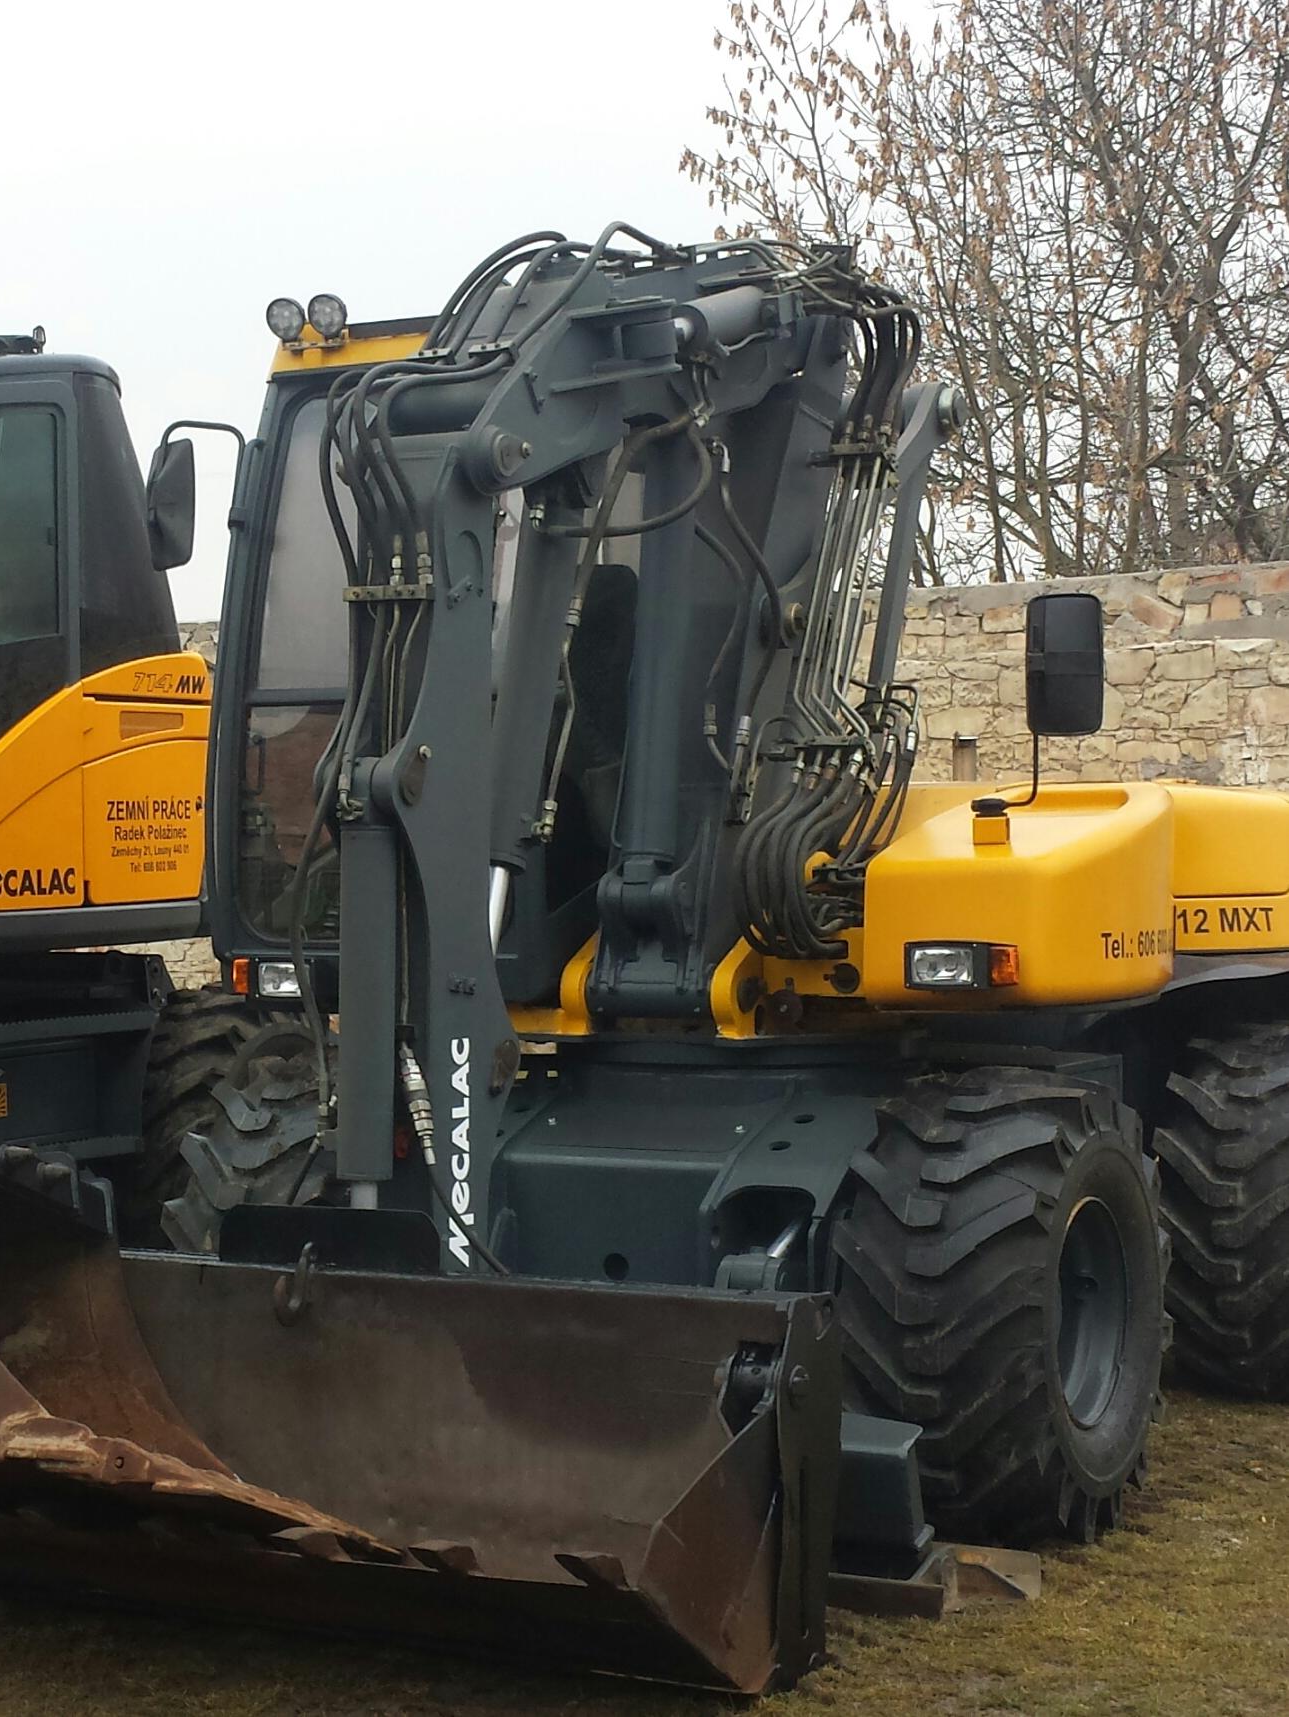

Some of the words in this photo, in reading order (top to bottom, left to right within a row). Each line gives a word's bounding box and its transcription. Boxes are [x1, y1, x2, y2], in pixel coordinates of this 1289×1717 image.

[175, 675, 206, 694] MW
[106, 796, 149, 821] ZEMNÍ
[152, 796, 191, 820] PRÁCE
[114, 826, 145, 841] Radek
[1177, 908, 1210, 934] 12
[1219, 907, 1273, 933] MXT
[1101, 932, 1134, 959] Tel.:
[1138, 930, 1155, 957] 606
